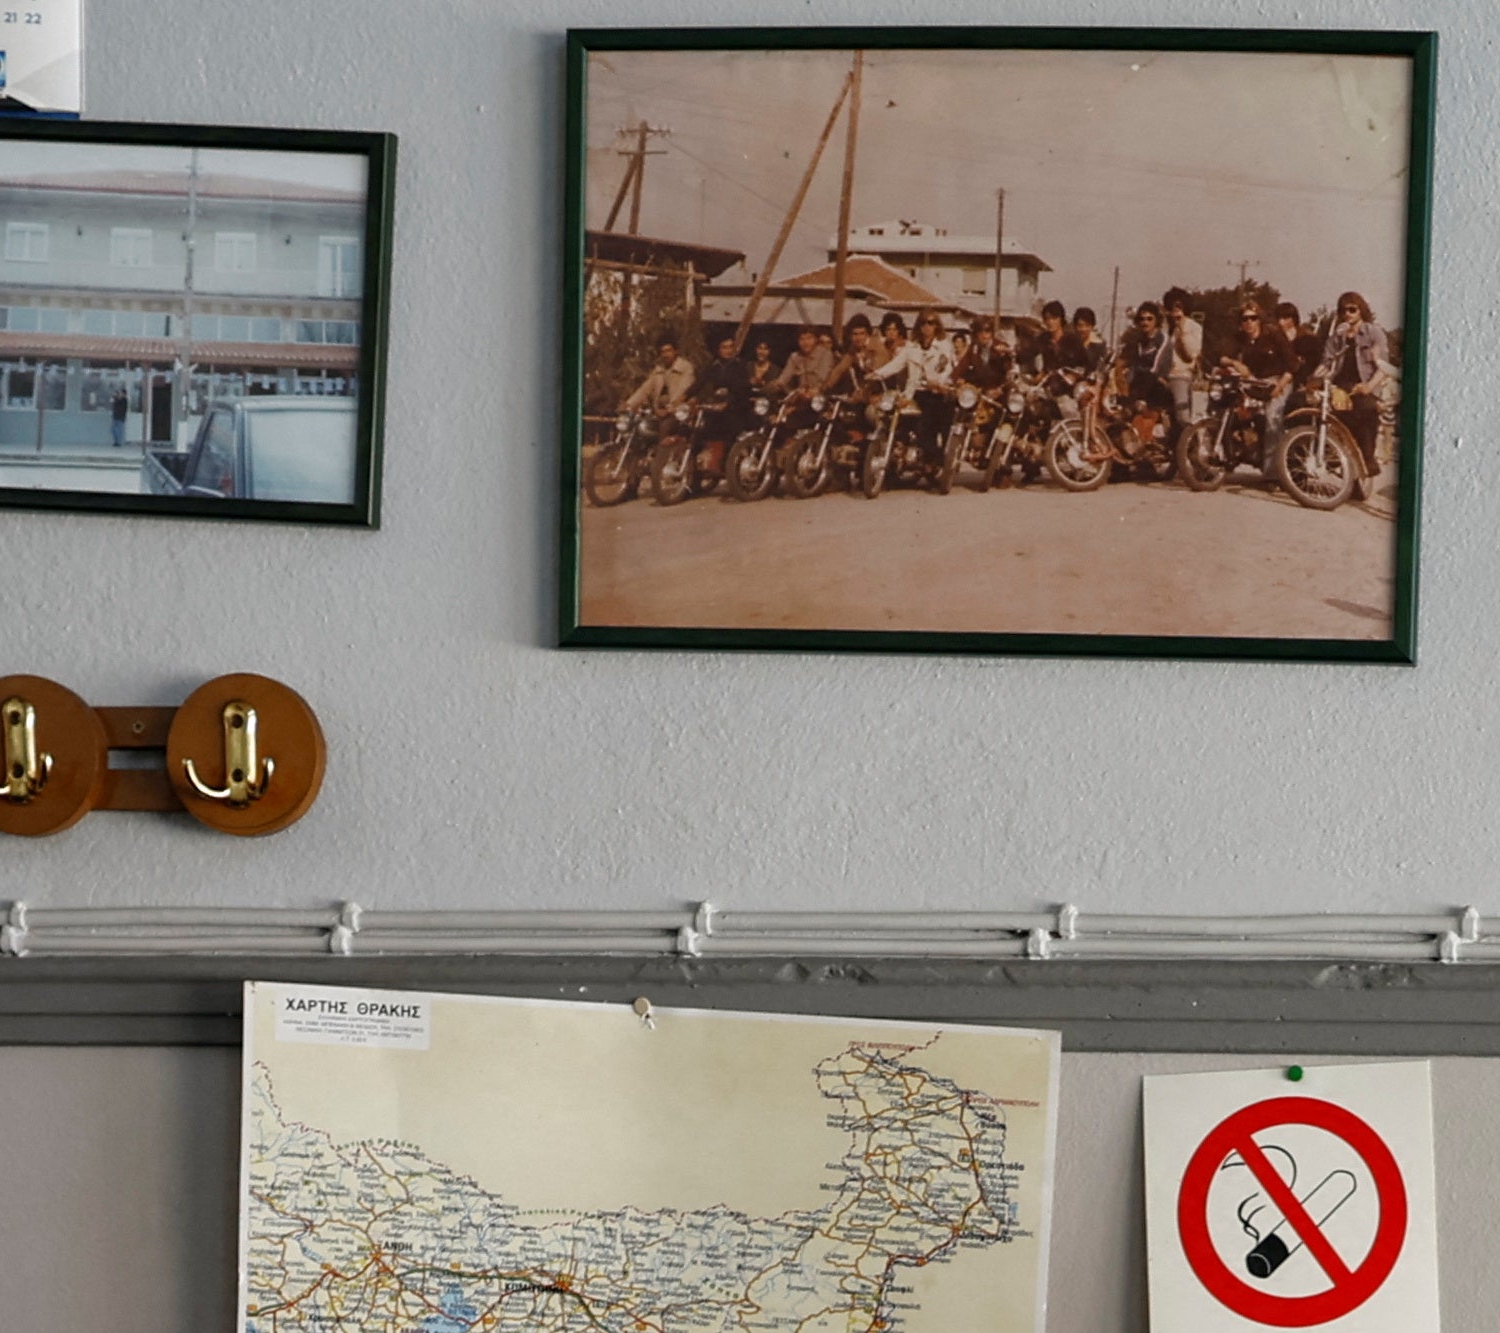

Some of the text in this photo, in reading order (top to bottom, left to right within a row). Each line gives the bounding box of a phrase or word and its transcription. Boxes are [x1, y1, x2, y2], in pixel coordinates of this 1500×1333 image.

[4, 12, 17, 23] 21
[25, 13, 42, 24] 22
[286, 998, 420, 1018] ΧΑΡΤΗΣ ΘΡΑΚΗΣ
